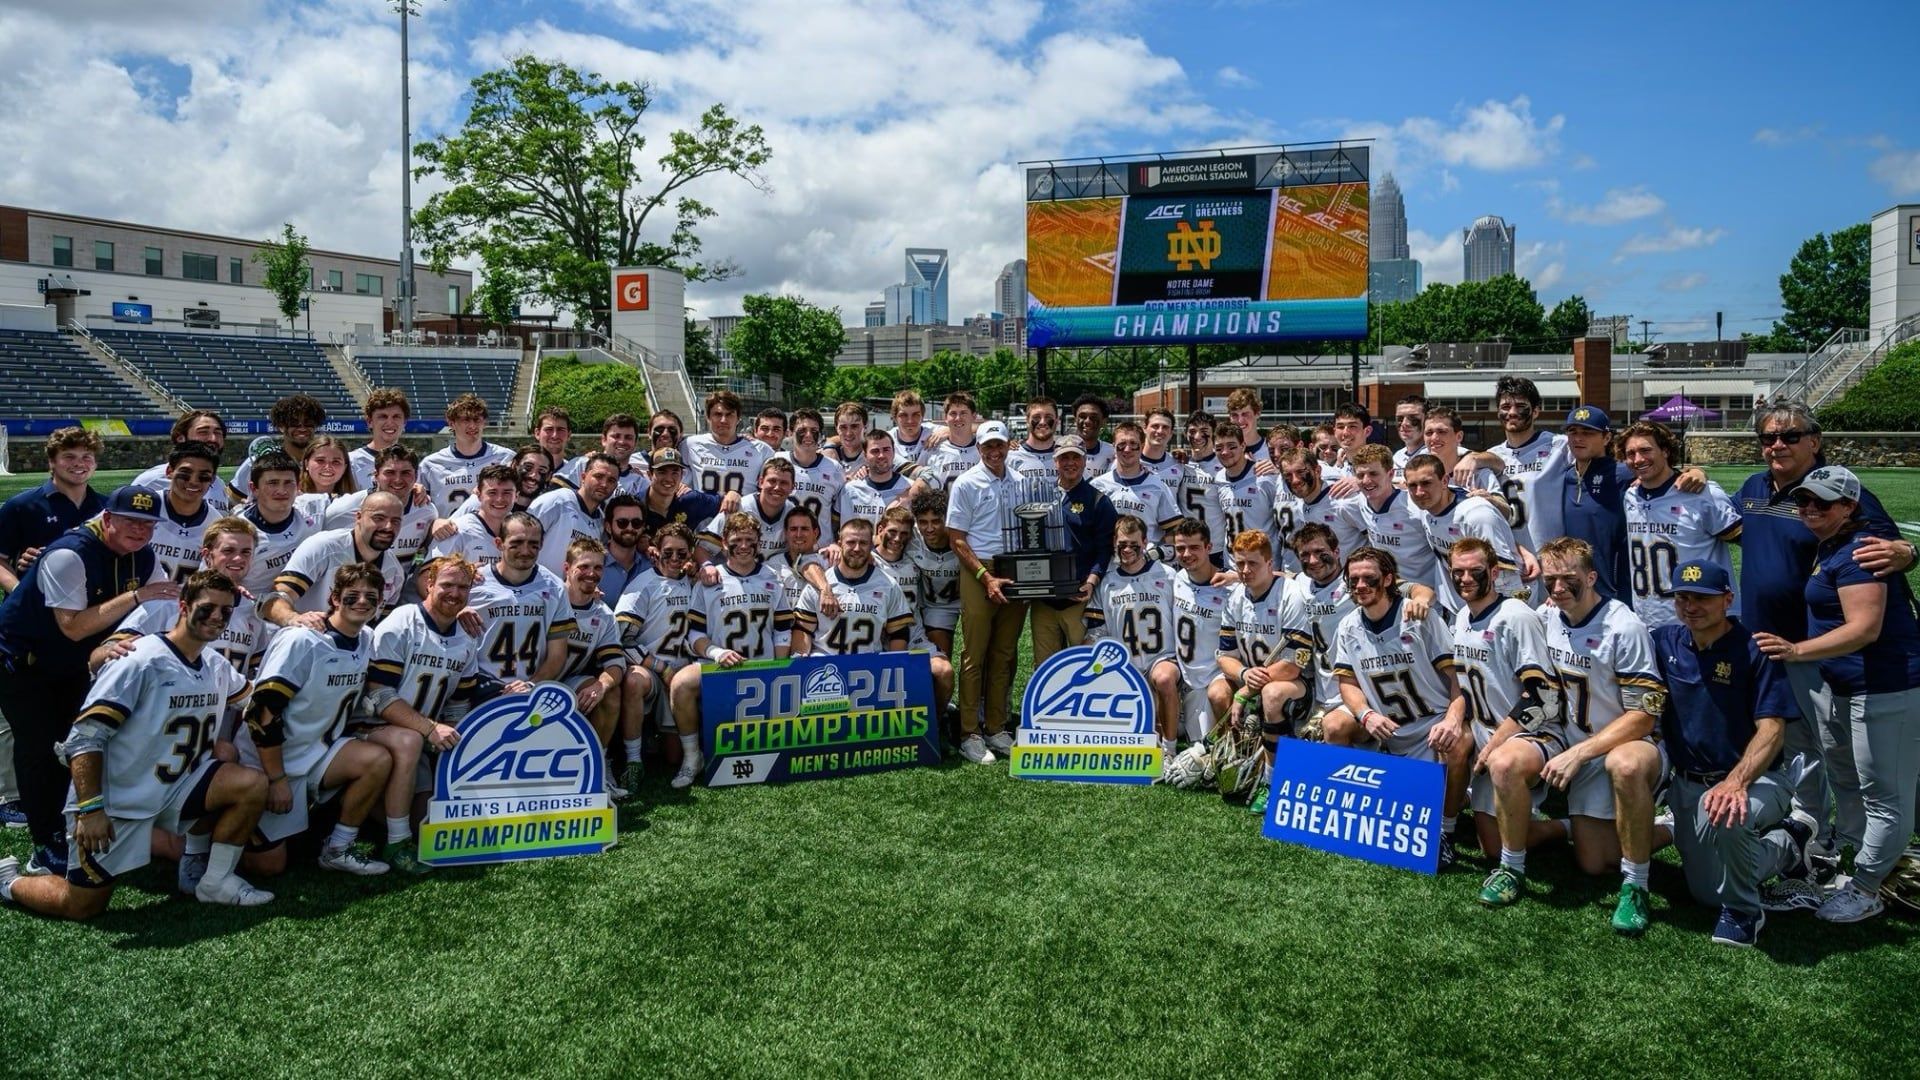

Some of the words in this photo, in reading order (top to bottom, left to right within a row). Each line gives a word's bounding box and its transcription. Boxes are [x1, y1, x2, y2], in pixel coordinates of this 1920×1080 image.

[1162, 164, 1207, 175] AMERICAN
[1209, 162, 1242, 172] LEGION
[1162, 173, 1208, 183] MEMORIAL
[1209, 171, 1248, 181] STADIUM
[1146, 204, 1186, 219] ACC
[1195, 206, 1243, 218] GREATNESS
[1340, 229, 1368, 248] AC
[1167, 279, 1191, 289] NOTRE
[1192, 278, 1215, 288] DAME
[1167, 300, 1197, 311] MEN'S
[1200, 299, 1249, 311] LACROSSE
[1114, 311, 1281, 337] CHAMPIONS
[699, 454, 725, 466] NOTRE
[727, 458, 749, 468] DAME
[1517, 462, 1543, 473] DAME
[444, 474, 473, 486] NOTRE
[1198, 475, 1215, 485] DAM
[806, 483, 826, 495] DAME
[853, 504, 877, 515] NOTRE
[1124, 499, 1145, 513] DAME
[1649, 522, 1678, 535] DAME
[398, 538, 420, 549] DAME
[1376, 533, 1401, 546] DAME
[1631, 539, 1679, 598] 80
[785, 587, 801, 598] TRE
[1111, 592, 1137, 604] NOTRE
[1139, 592, 1161, 604] DAME
[666, 595, 688, 607] NOTRE
[720, 593, 748, 608] NOTRE
[750, 593, 771, 604] DAME
[488, 605, 520, 619] NOTRE
[523, 604, 545, 617] DAME
[855, 603, 878, 615] DAME
[723, 608, 770, 659] 27
[1122, 607, 1163, 657] 43
[1236, 621, 1252, 633] OTRE
[230, 631, 252, 646] DAME
[569, 630, 593, 643] DAME
[826, 616, 875, 655] 42
[487, 620, 542, 678] 44
[1466, 645, 1488, 662] DAME
[410, 652, 443, 669] NOTRE
[446, 658, 466, 673] DAME
[1360, 655, 1388, 670] NOTRE
[1564, 650, 1592, 669] DAME
[327, 673, 358, 687] NOTRE
[811, 681, 841, 693] ACC
[169, 693, 205, 709] NOTRE
[415, 672, 451, 719] 11
[1369, 668, 1438, 727] 51
[1045, 692, 1141, 719] ACC
[715, 706, 929, 754] CHAMPIONS
[1029, 733, 1072, 745] MEN'S
[1076, 733, 1145, 746] LACROSSE
[466, 747, 588, 783] ACC
[790, 752, 839, 774] MEN'S
[844, 745, 919, 770] LACROSSE
[1020, 752, 1153, 771] CHAMPIONSHIP
[1329, 764, 1387, 786] ACC
[445, 802, 500, 819] MEN'S
[507, 797, 593, 814] LACROSSE
[1279, 779, 1432, 825] ACCOMPLISH
[434, 816, 604, 852] CHAMPIONSHIP
[1274, 798, 1429, 858] GREATNESS
